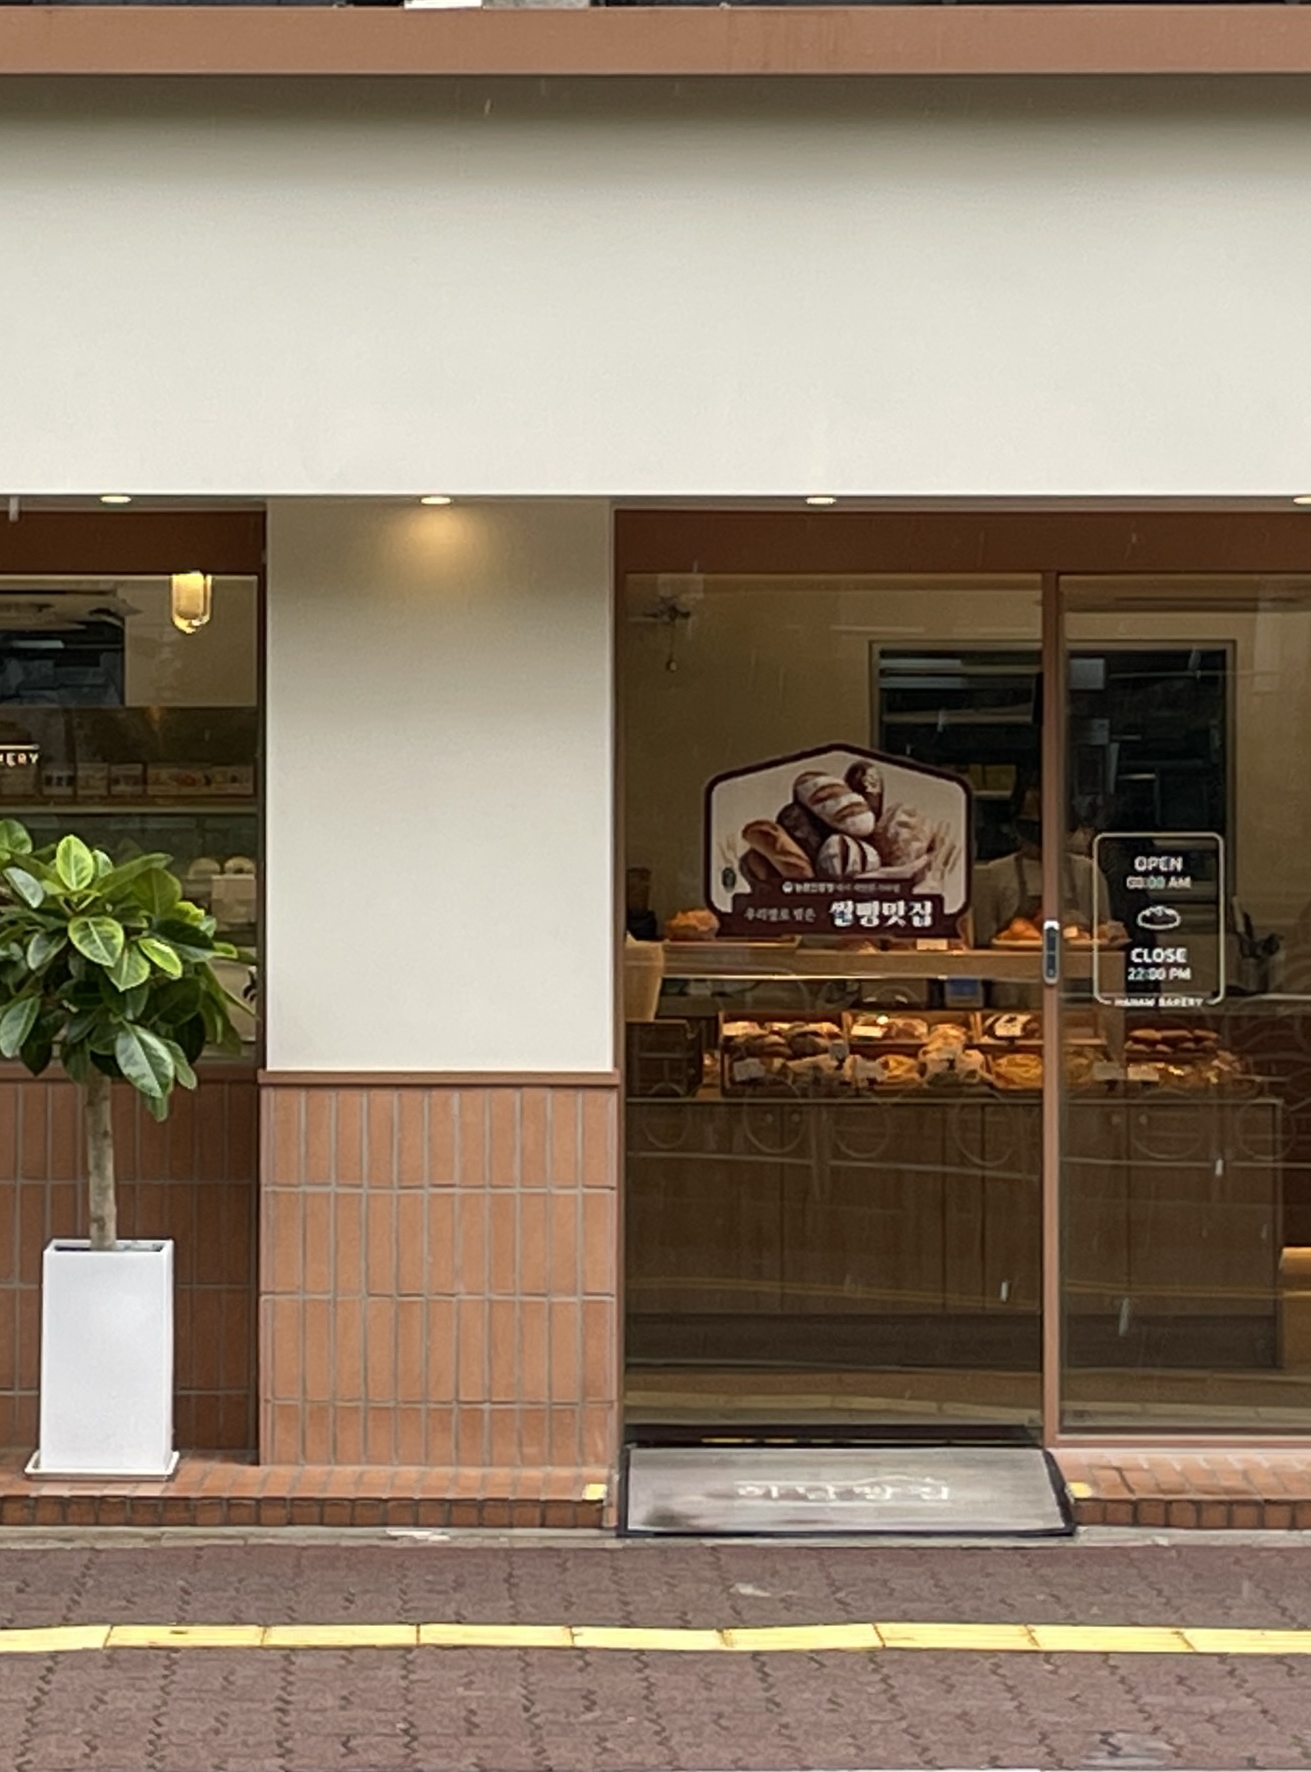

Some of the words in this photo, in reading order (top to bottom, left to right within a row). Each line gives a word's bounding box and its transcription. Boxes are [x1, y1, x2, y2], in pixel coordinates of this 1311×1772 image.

[1134, 856, 1183, 872] OPEN
[1167, 876, 1192, 889] AM
[828, 900, 934, 929] 쌀빵맛집
[1130, 948, 1187, 963] CLOSE
[1127, 968, 1165, 981] 22:00
[1169, 968, 1192, 981] PM
